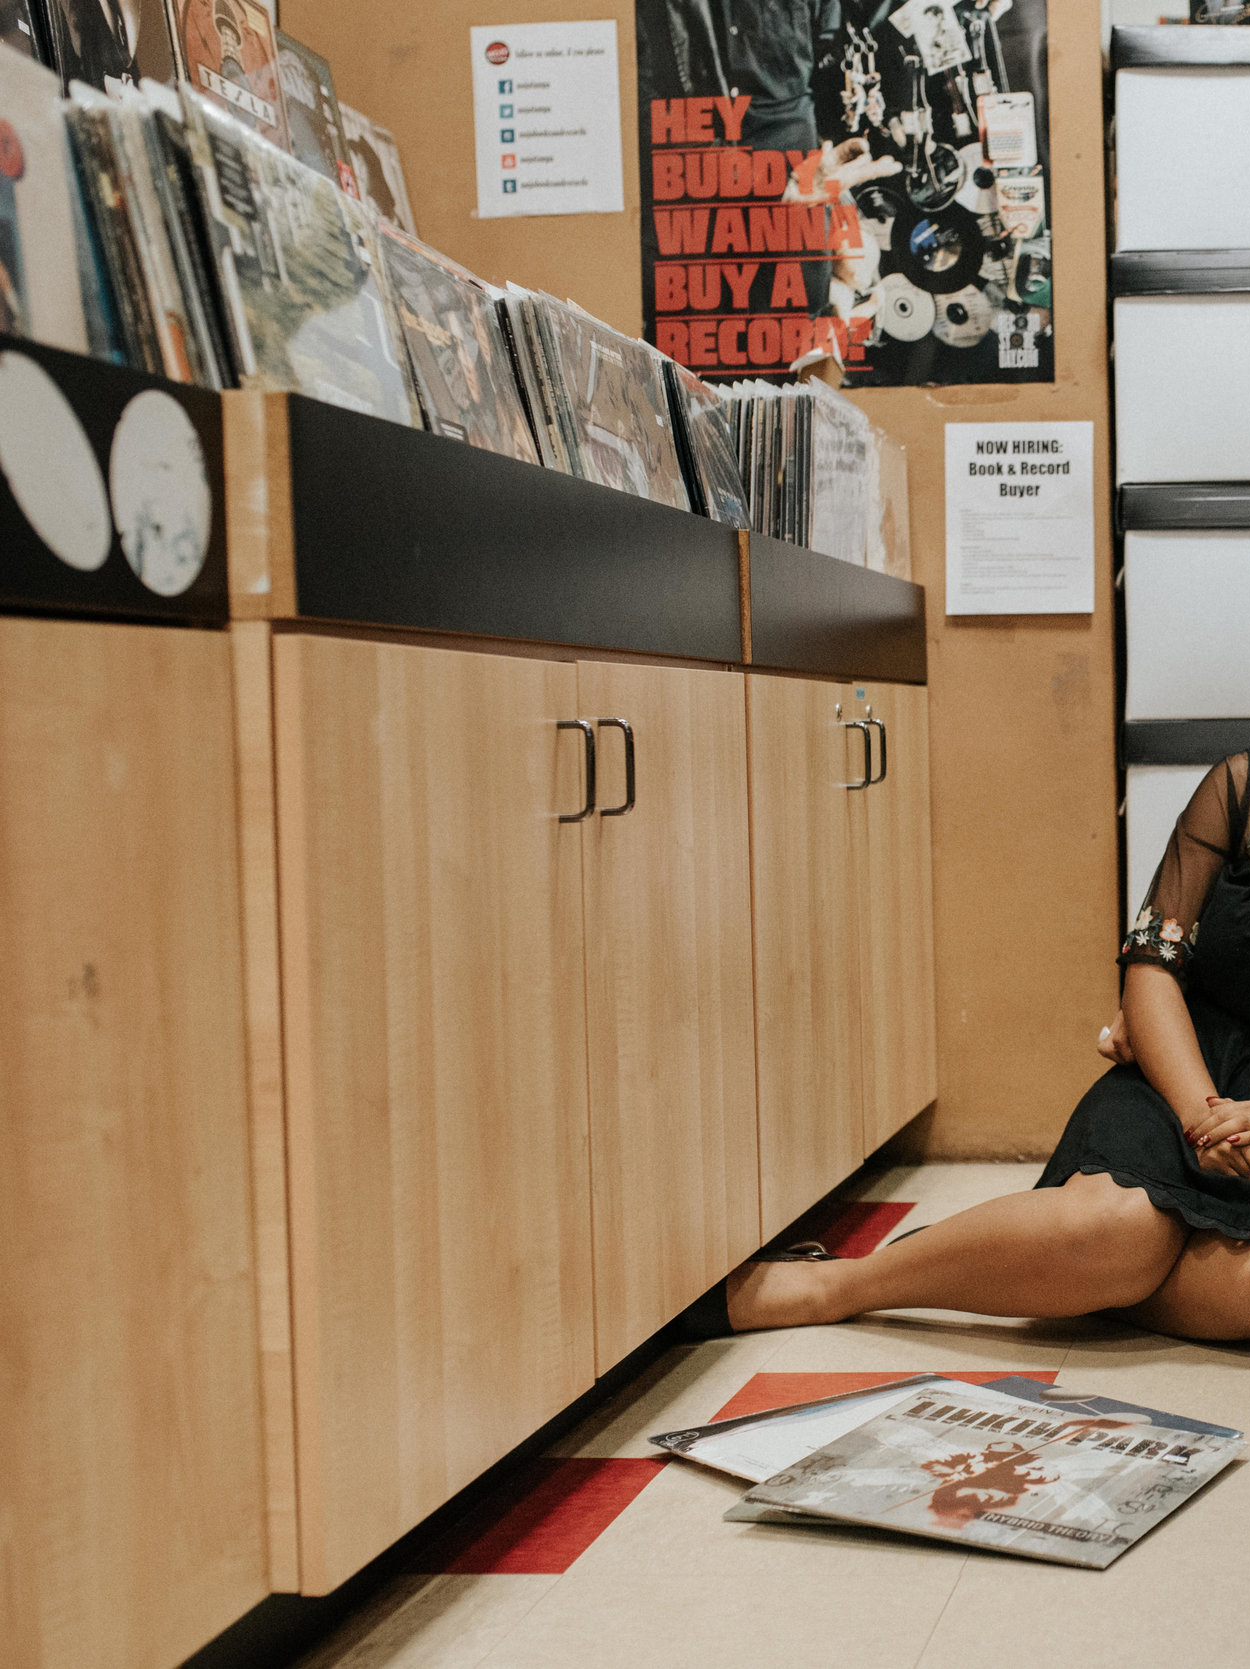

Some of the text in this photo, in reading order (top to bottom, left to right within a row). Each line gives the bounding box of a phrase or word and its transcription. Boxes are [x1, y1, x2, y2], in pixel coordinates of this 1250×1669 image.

[203, 69, 271, 122] TESLA
[650, 95, 752, 144] HEY
[652, 150, 841, 204] BUDDY,
[653, 205, 864, 255] WANNA
[655, 261, 808, 312] BUY A
[969, 461, 1070, 476] Book & Record
[976, 440, 1063, 455] NOW HIRING:
[999, 483, 1040, 498] Buyer
[1066, 1428, 1195, 1466] PARK
